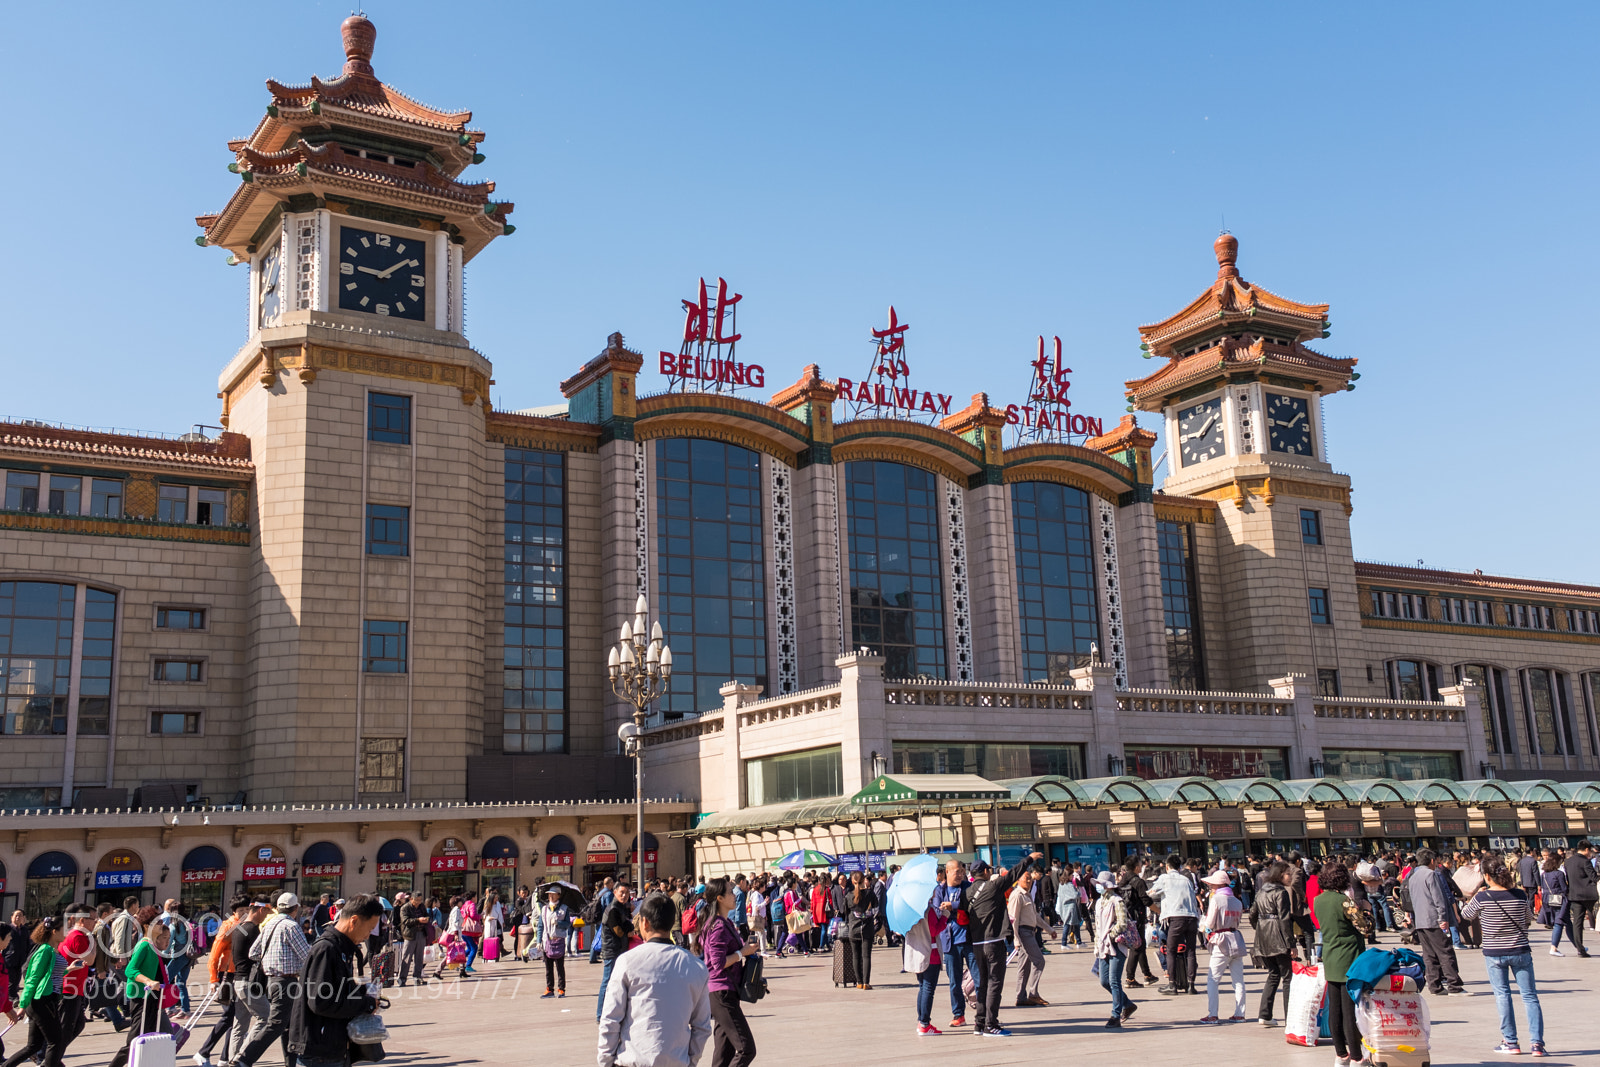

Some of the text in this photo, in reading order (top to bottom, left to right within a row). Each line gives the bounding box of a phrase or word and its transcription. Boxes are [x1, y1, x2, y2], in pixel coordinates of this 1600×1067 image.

[375, 233, 391, 247] 12
[340, 262, 354, 275] 9
[411, 274, 425, 287] 3
[375, 303, 390, 316] 6
[682, 277, 1072, 407] 北 京 站
[659, 351, 1103, 437] BEIJING RAILWAY STATION
[1282, 396, 1290, 405] 12
[1195, 404, 1204, 414] 12
[1216, 422, 1224, 432] 3
[1302, 423, 1310, 432] 3
[1200, 452, 1208, 462] 6
[551, 856, 571, 865] 超市
[184, 870, 224, 881] 北京特产
[245, 866, 286, 876] 华联超市
[97, 873, 143, 885] 站区寄存
